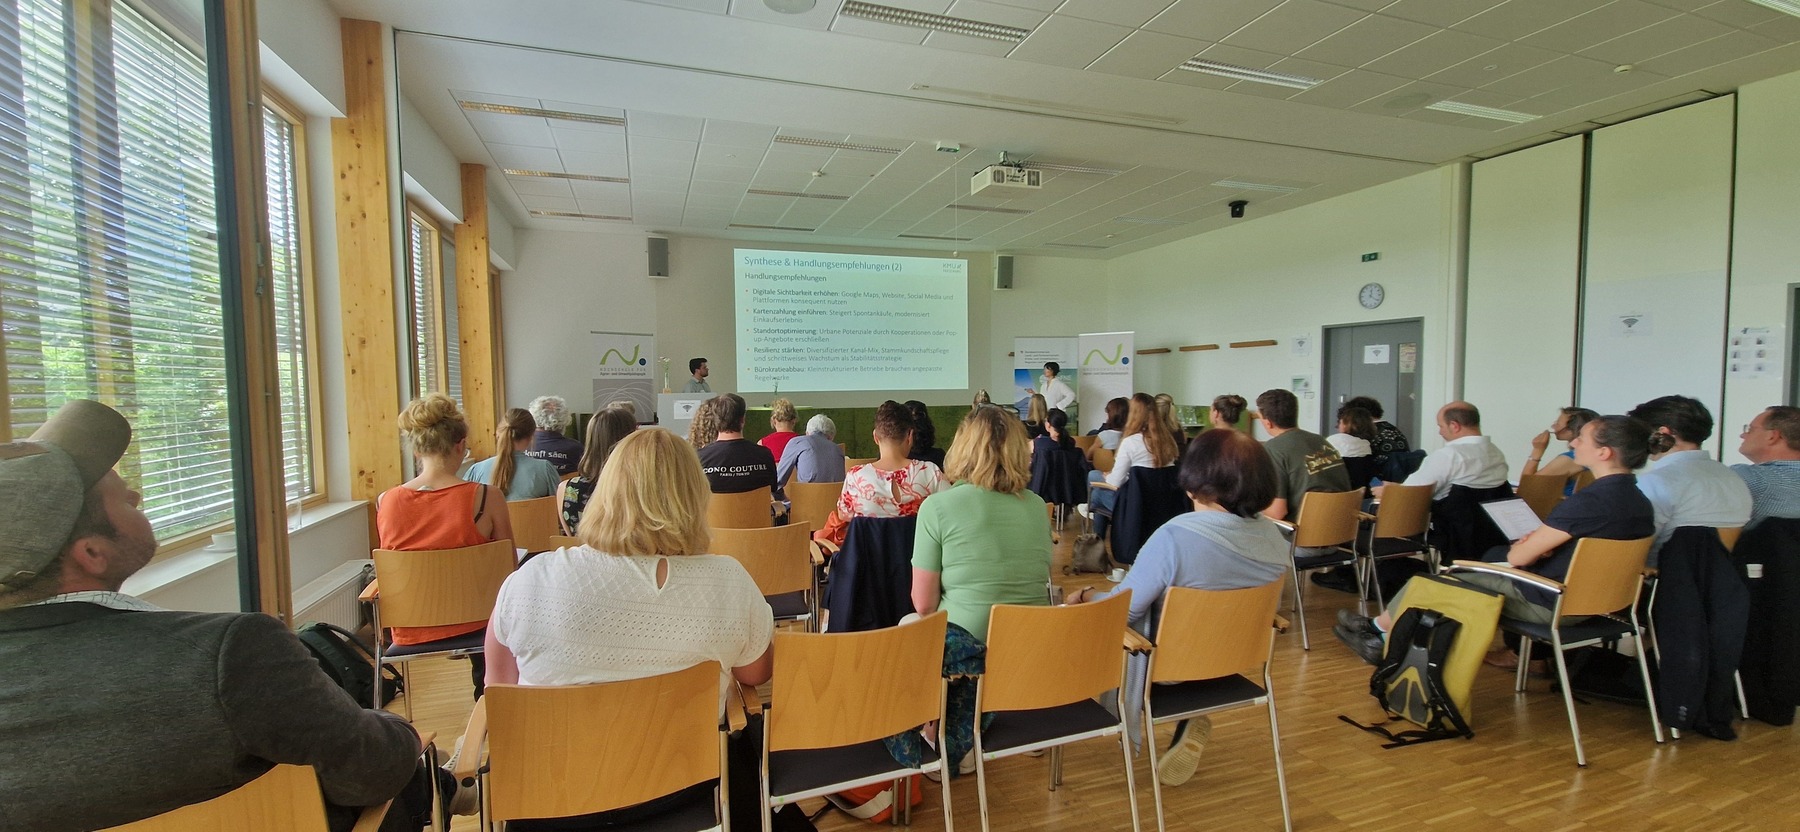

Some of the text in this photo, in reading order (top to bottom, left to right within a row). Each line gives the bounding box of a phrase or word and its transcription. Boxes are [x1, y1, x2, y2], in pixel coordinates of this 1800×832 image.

[744, 256, 902, 272] Synthese & Handlungsempfehlungen (2)
[744, 272, 827, 282] Handlungsempfehlungen
[752, 288, 776, 296] Digitale
[841, 290, 862, 298] Google
[752, 296, 789, 304] Plattformen
[790, 298, 826, 306] konsequent
[753, 308, 796, 316] Kartenzahlung
[753, 328, 817, 336] Standortoptimierung:
[525, 450, 568, 459] kunft säen
[729, 464, 768, 473] COUTURE
